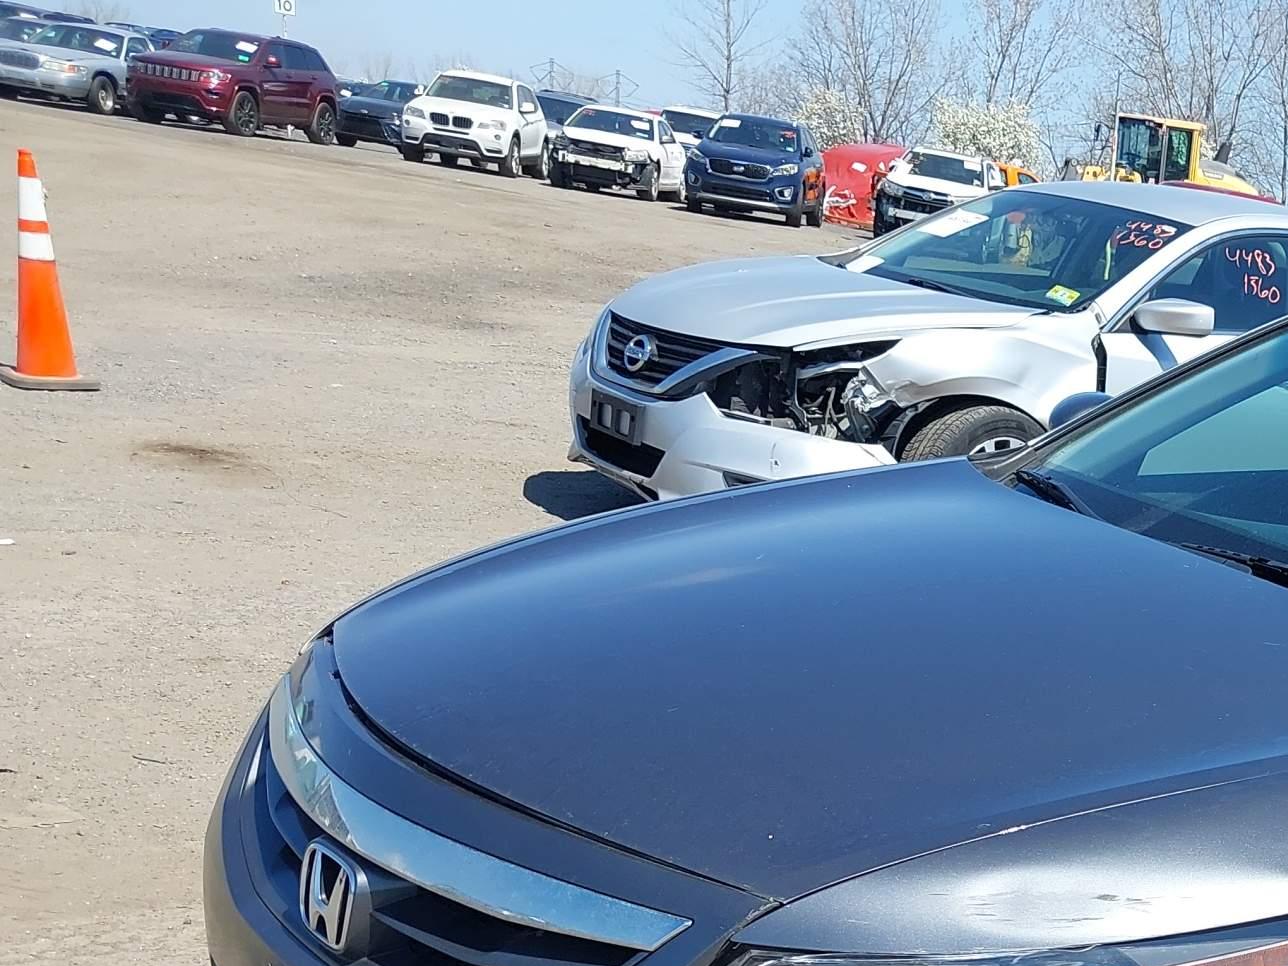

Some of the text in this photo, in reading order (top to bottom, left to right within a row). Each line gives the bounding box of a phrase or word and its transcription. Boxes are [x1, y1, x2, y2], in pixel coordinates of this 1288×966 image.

[278, 0, 292, 11] 10
[1225, 247, 1275, 276] 4483
[1244, 272, 1280, 304] 1560
